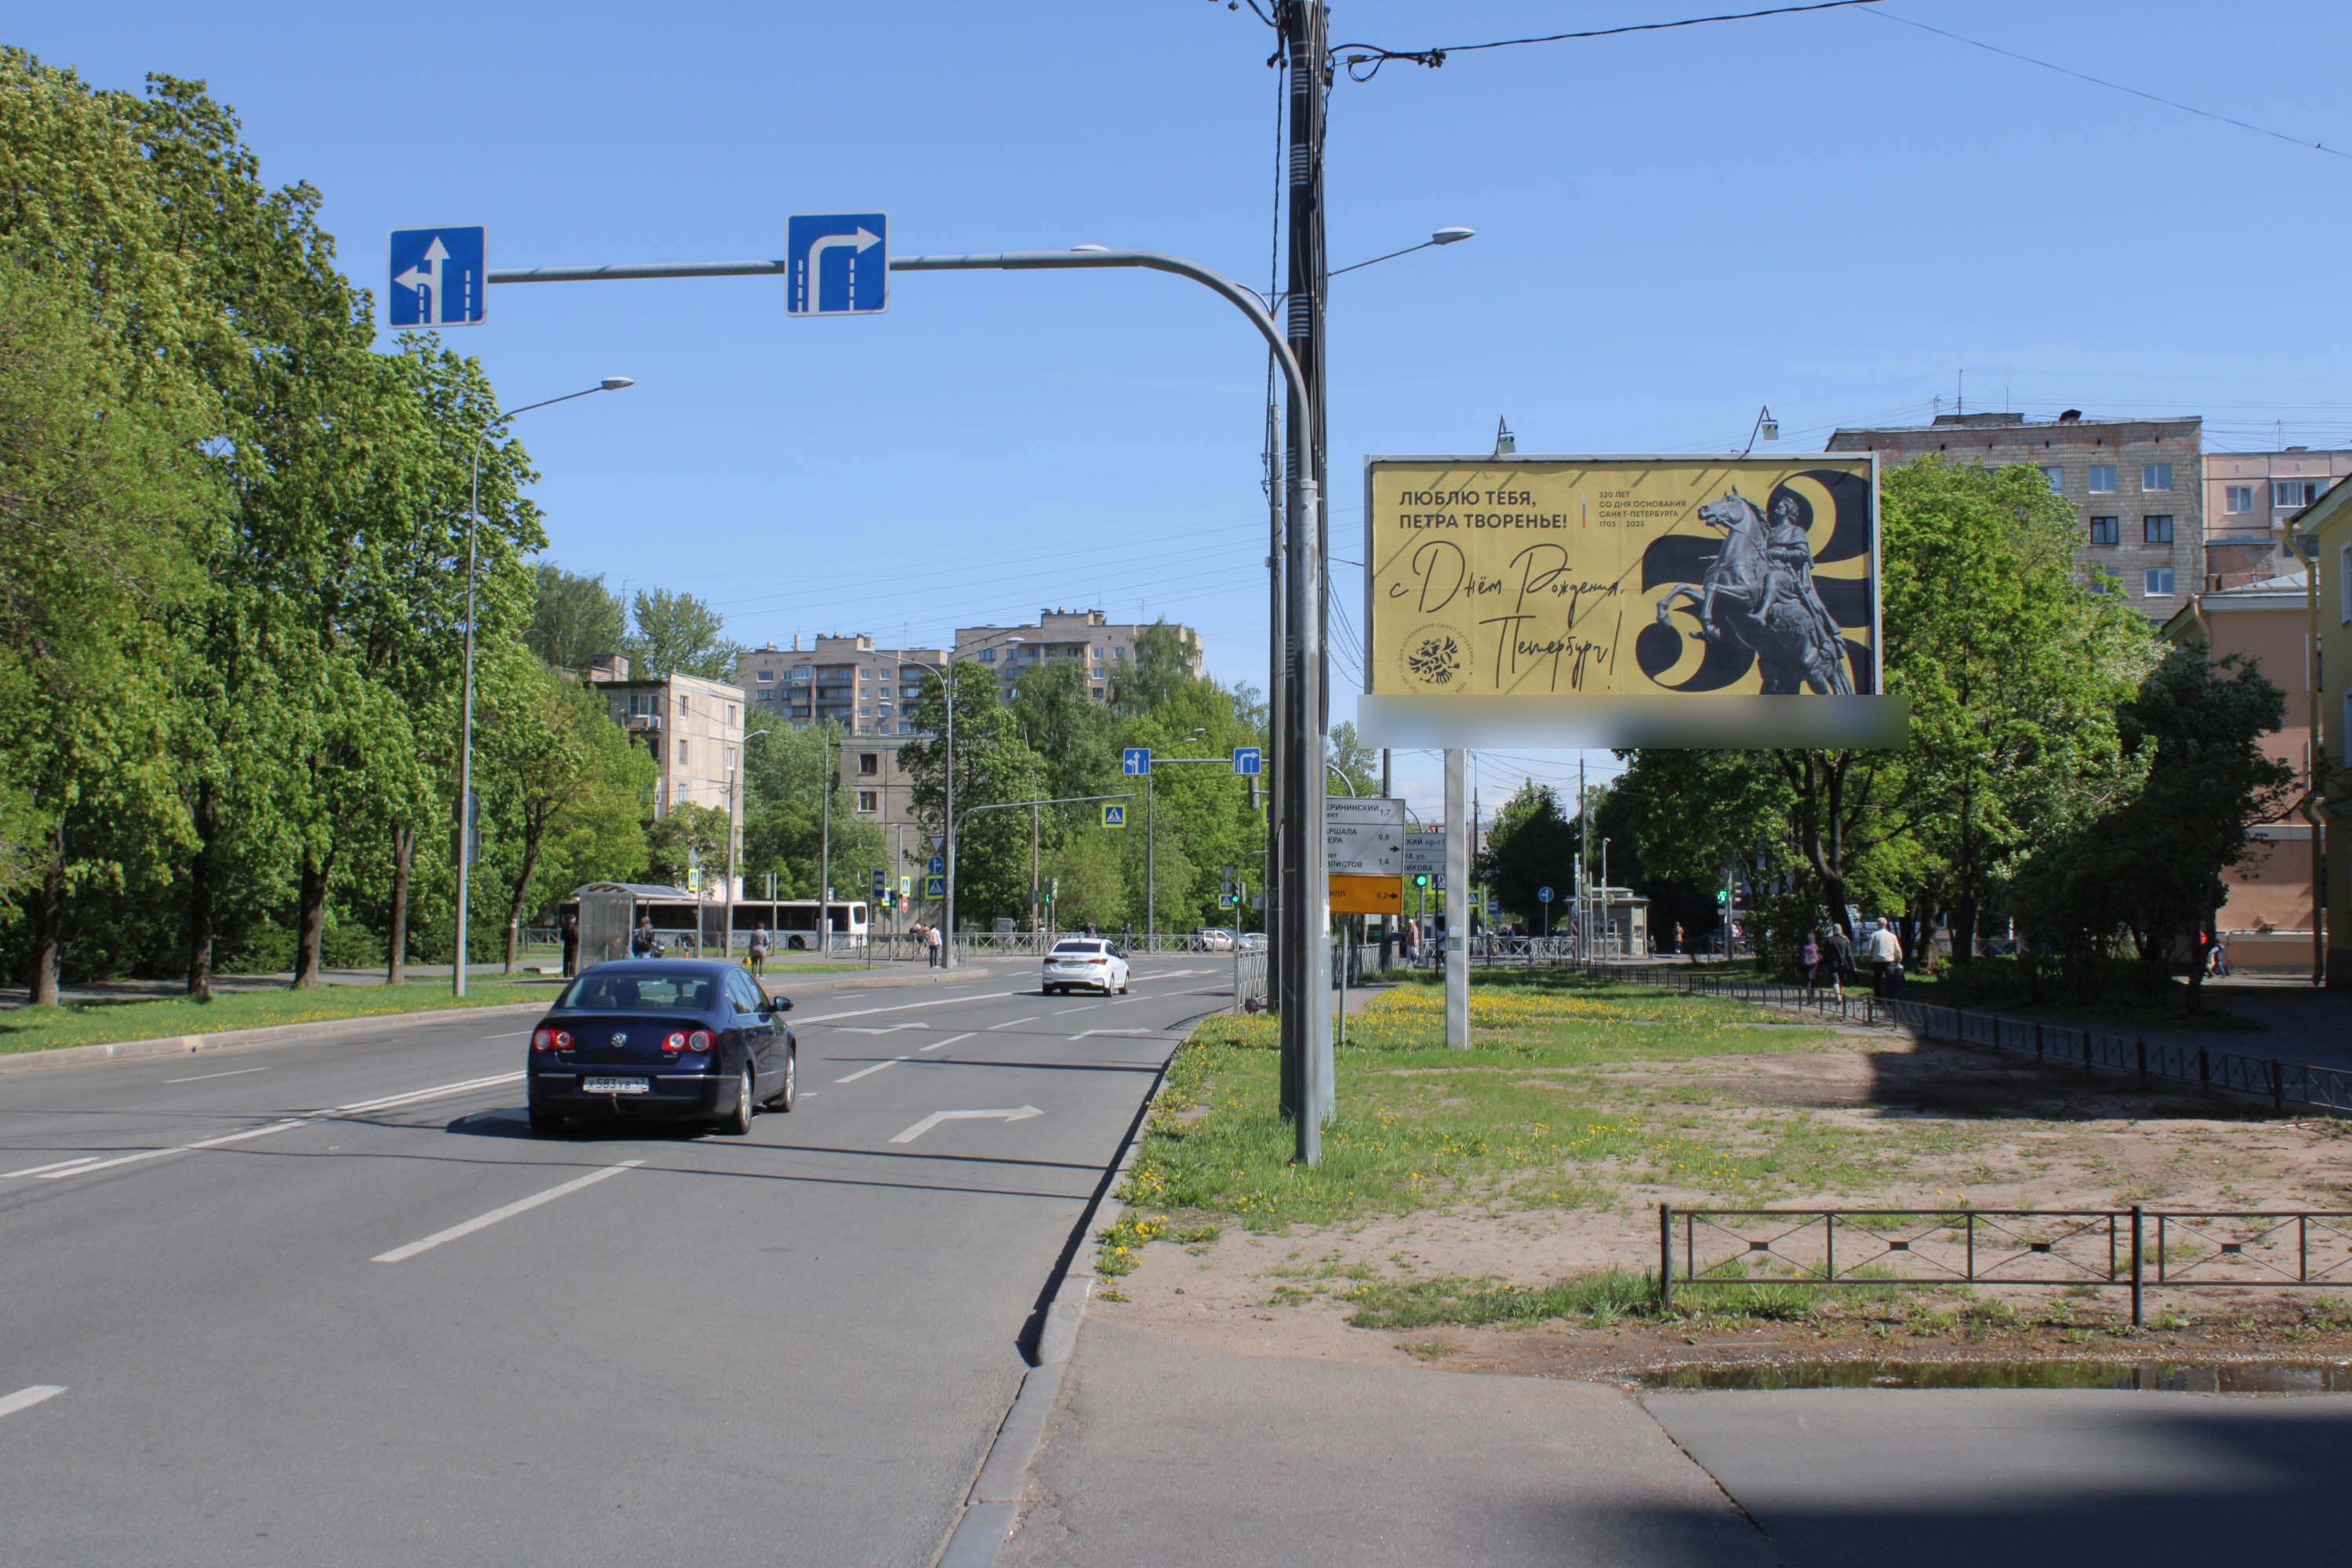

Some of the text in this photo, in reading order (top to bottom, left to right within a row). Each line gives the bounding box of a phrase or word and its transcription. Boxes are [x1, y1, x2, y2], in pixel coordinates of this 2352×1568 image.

[1399, 491, 1537, 509] ЛЮБЛЮ ТЕБЯ,
[1399, 514, 1567, 528] ПЕТРА ТВОРЕНЬЕ!
[1412, 540, 1502, 613] Днём
